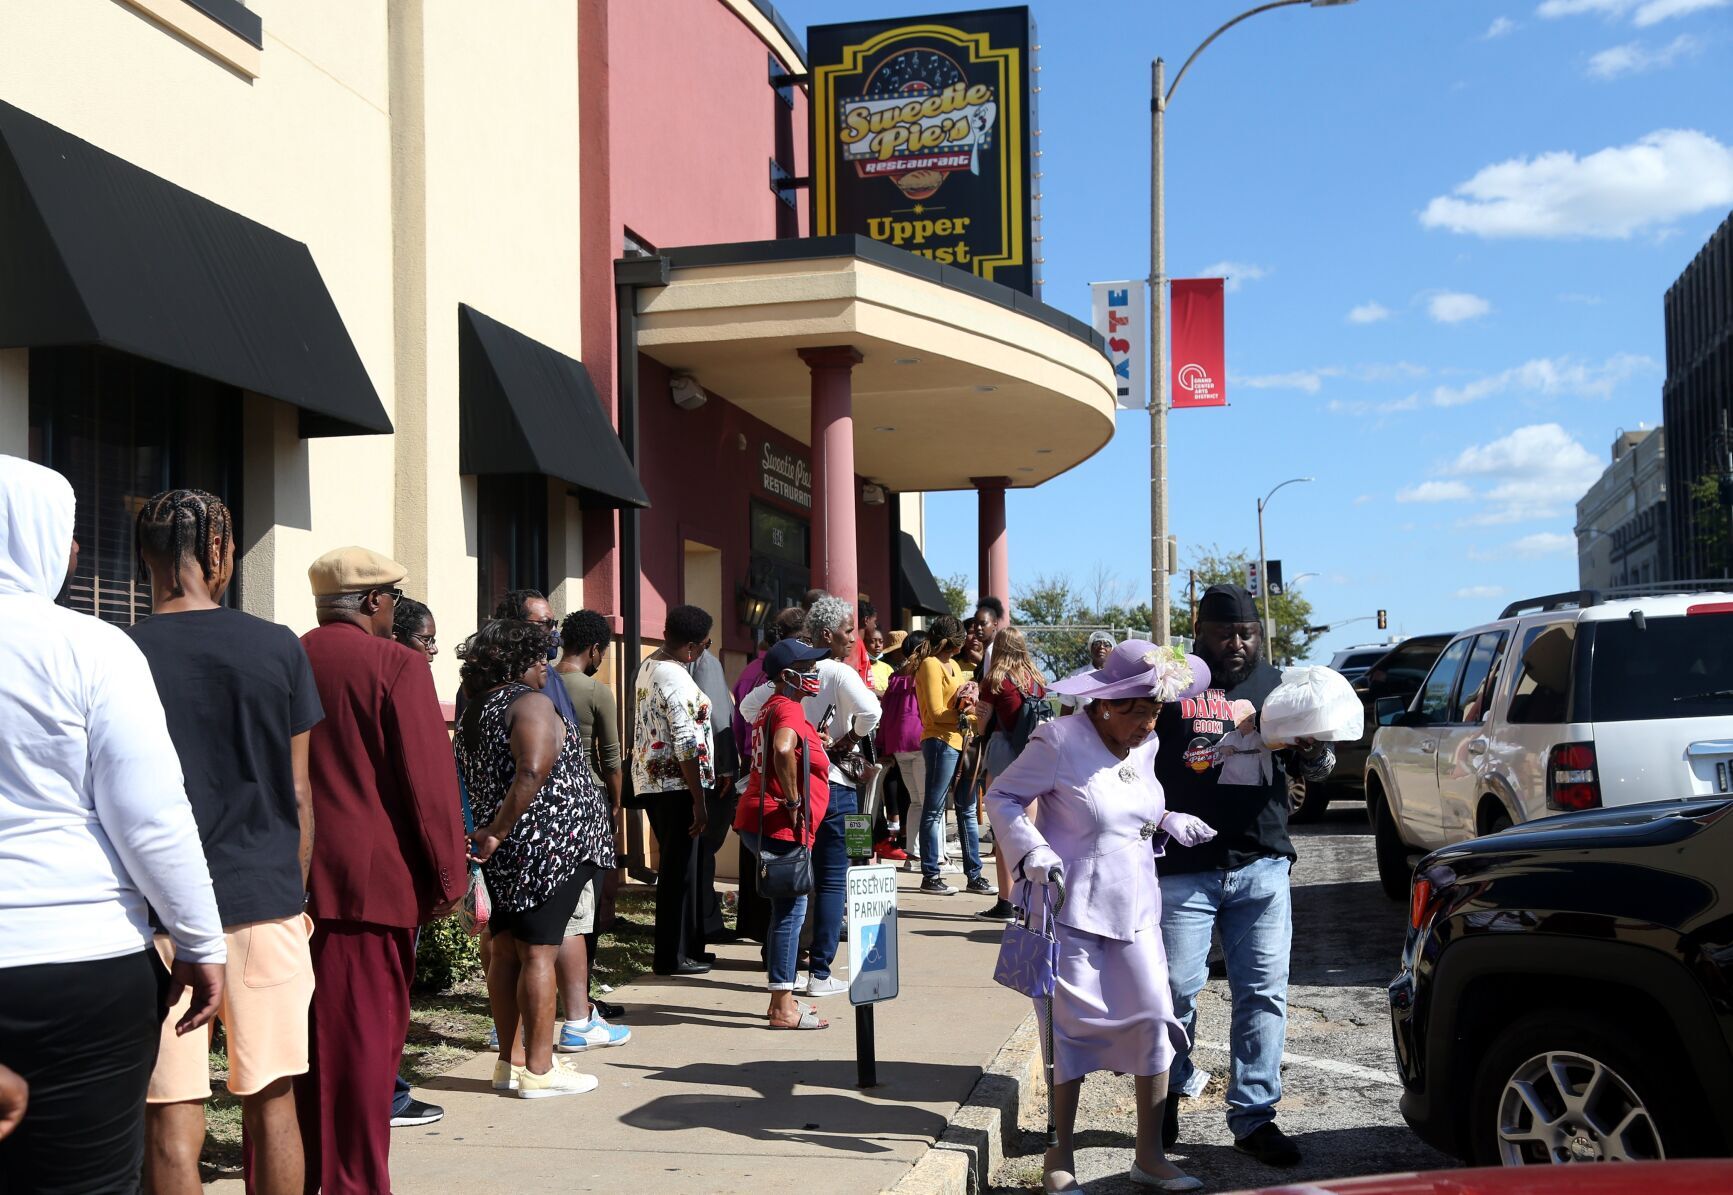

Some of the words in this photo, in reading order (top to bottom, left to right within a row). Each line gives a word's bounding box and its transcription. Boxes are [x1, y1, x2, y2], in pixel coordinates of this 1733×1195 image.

[840, 82, 992, 143] Sweetie
[870, 115, 970, 160] Pie's
[867, 217, 970, 244] Upper
[910, 241, 970, 264] ust
[762, 442, 794, 480] Sweetie
[1181, 698, 1234, 721] DAMN
[850, 877, 895, 896] RESERVED
[854, 900, 892, 919] PARKING
